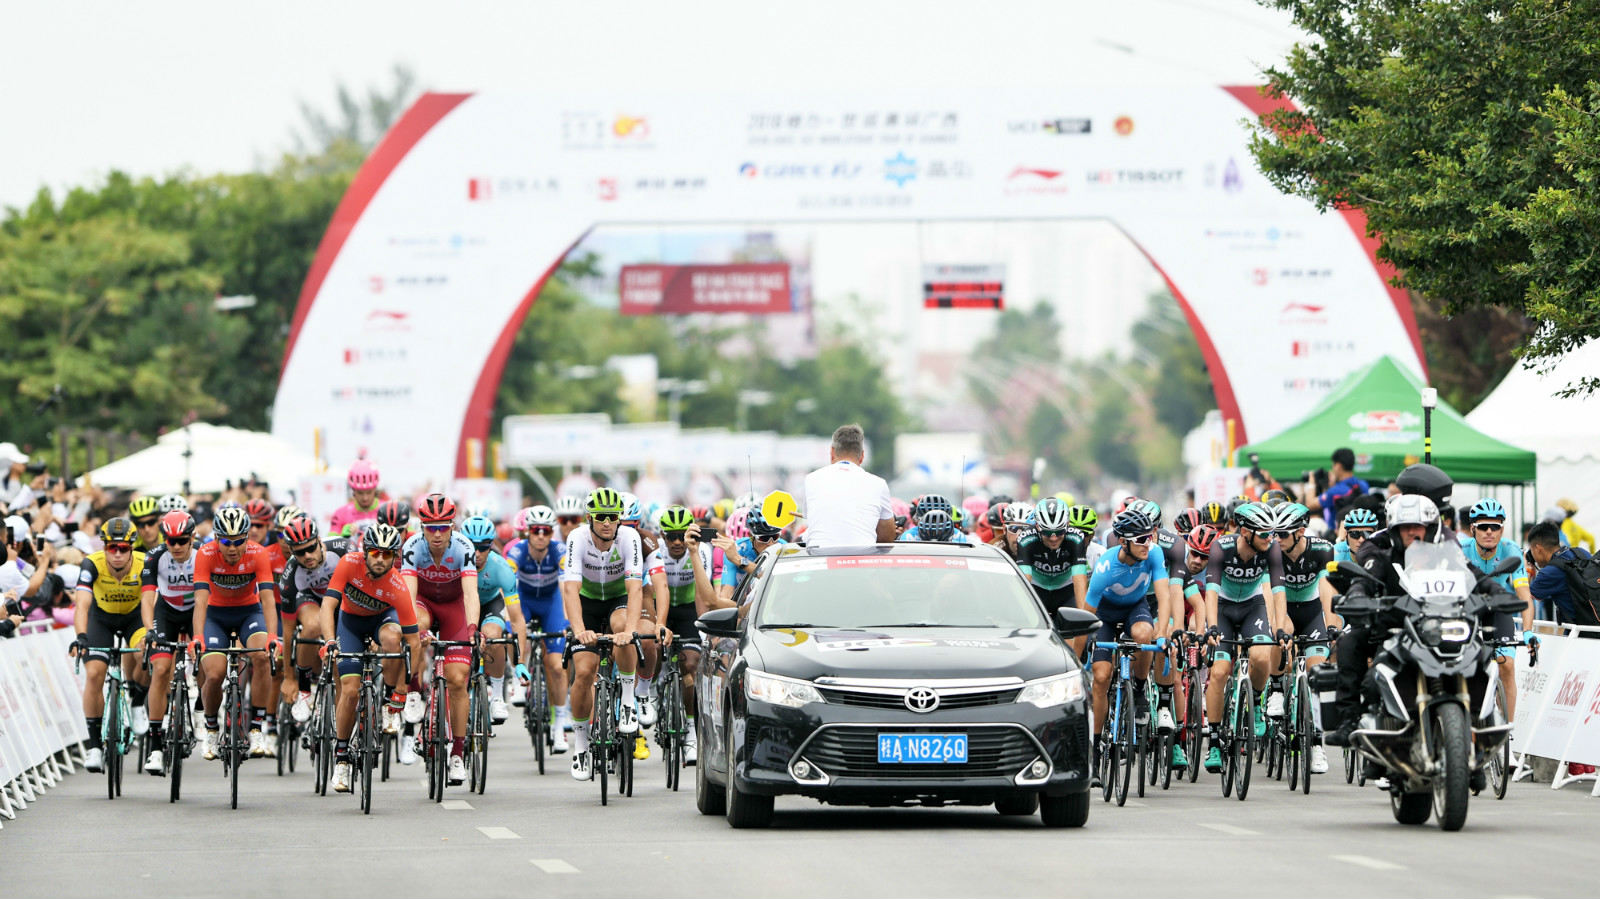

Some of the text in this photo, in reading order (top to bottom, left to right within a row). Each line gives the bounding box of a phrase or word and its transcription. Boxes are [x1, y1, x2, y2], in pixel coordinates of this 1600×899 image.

[333, 541, 347, 549] UAE
[1033, 560, 1071, 573] BORA
[1224, 566, 1264, 578] BORA
[417, 569, 460, 579] Alpecin
[1423, 580, 1455, 594] 107
[346, 585, 389, 609] BAHRAIN
